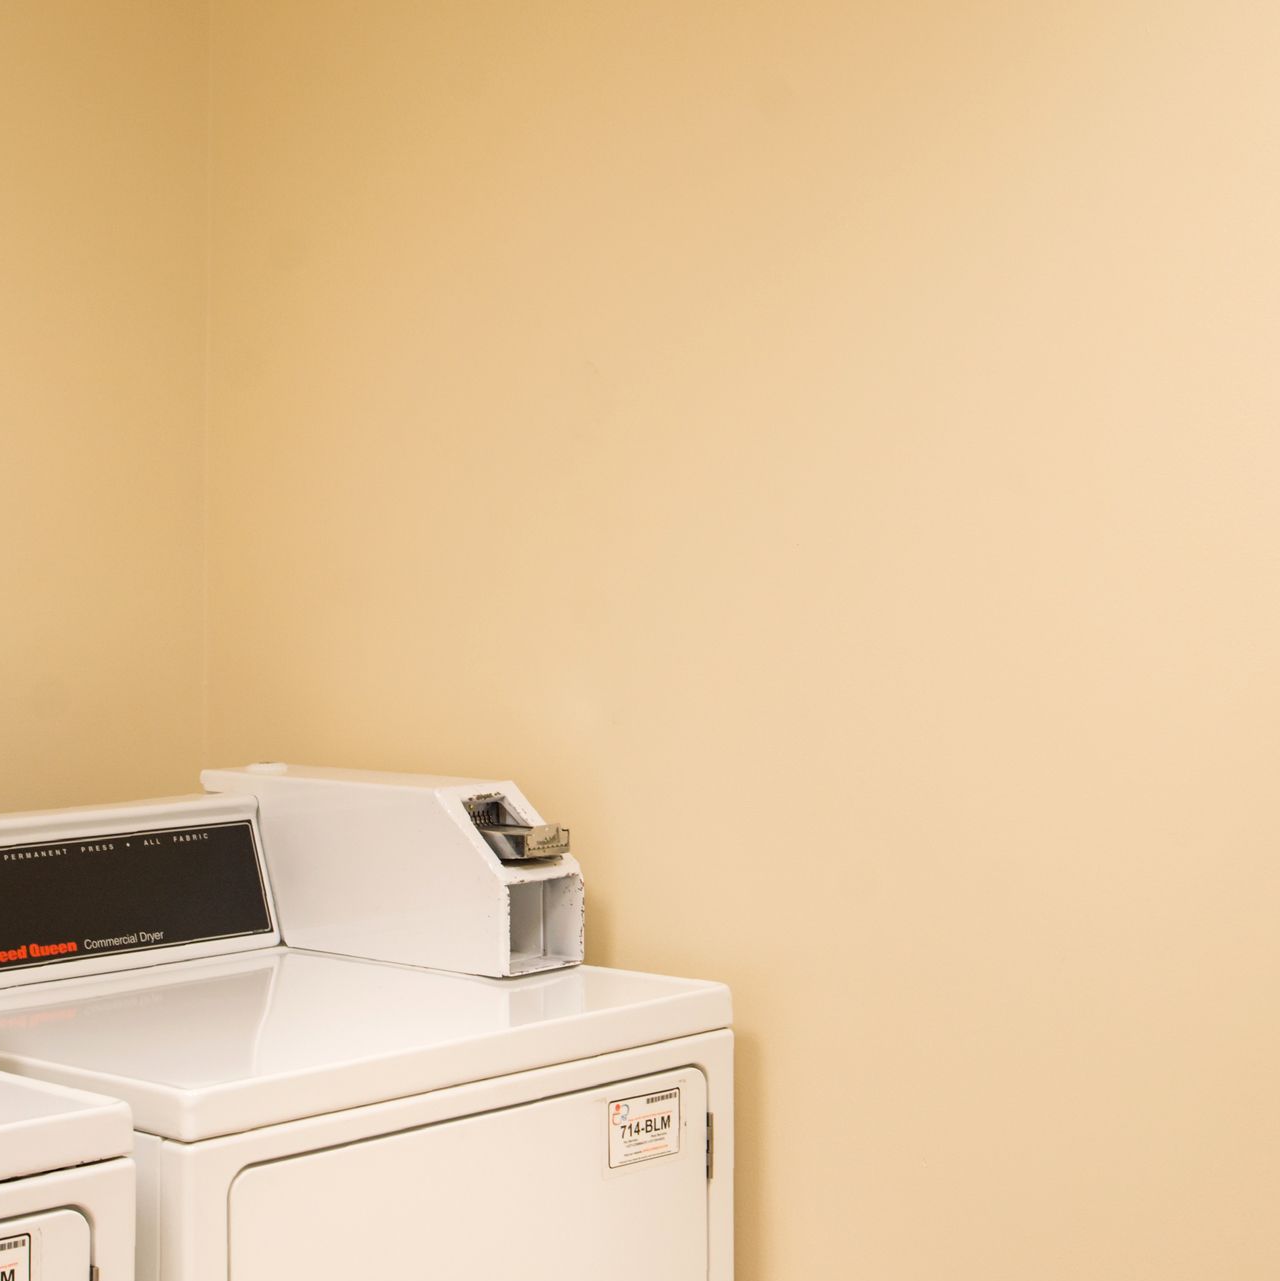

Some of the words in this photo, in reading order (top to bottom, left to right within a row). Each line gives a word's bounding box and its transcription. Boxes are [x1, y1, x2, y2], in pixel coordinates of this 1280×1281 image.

[4, 848, 68, 861] PERMANENT
[81, 843, 115, 853] PRESS
[144, 838, 161, 846] ALL
[173, 832, 209, 843] FABRIC
[29, 940, 78, 958] Queen
[84, 932, 138, 950] Commercial
[140, 929, 164, 943] Dryer
[620, 1115, 671, 1139] 714-BLM
